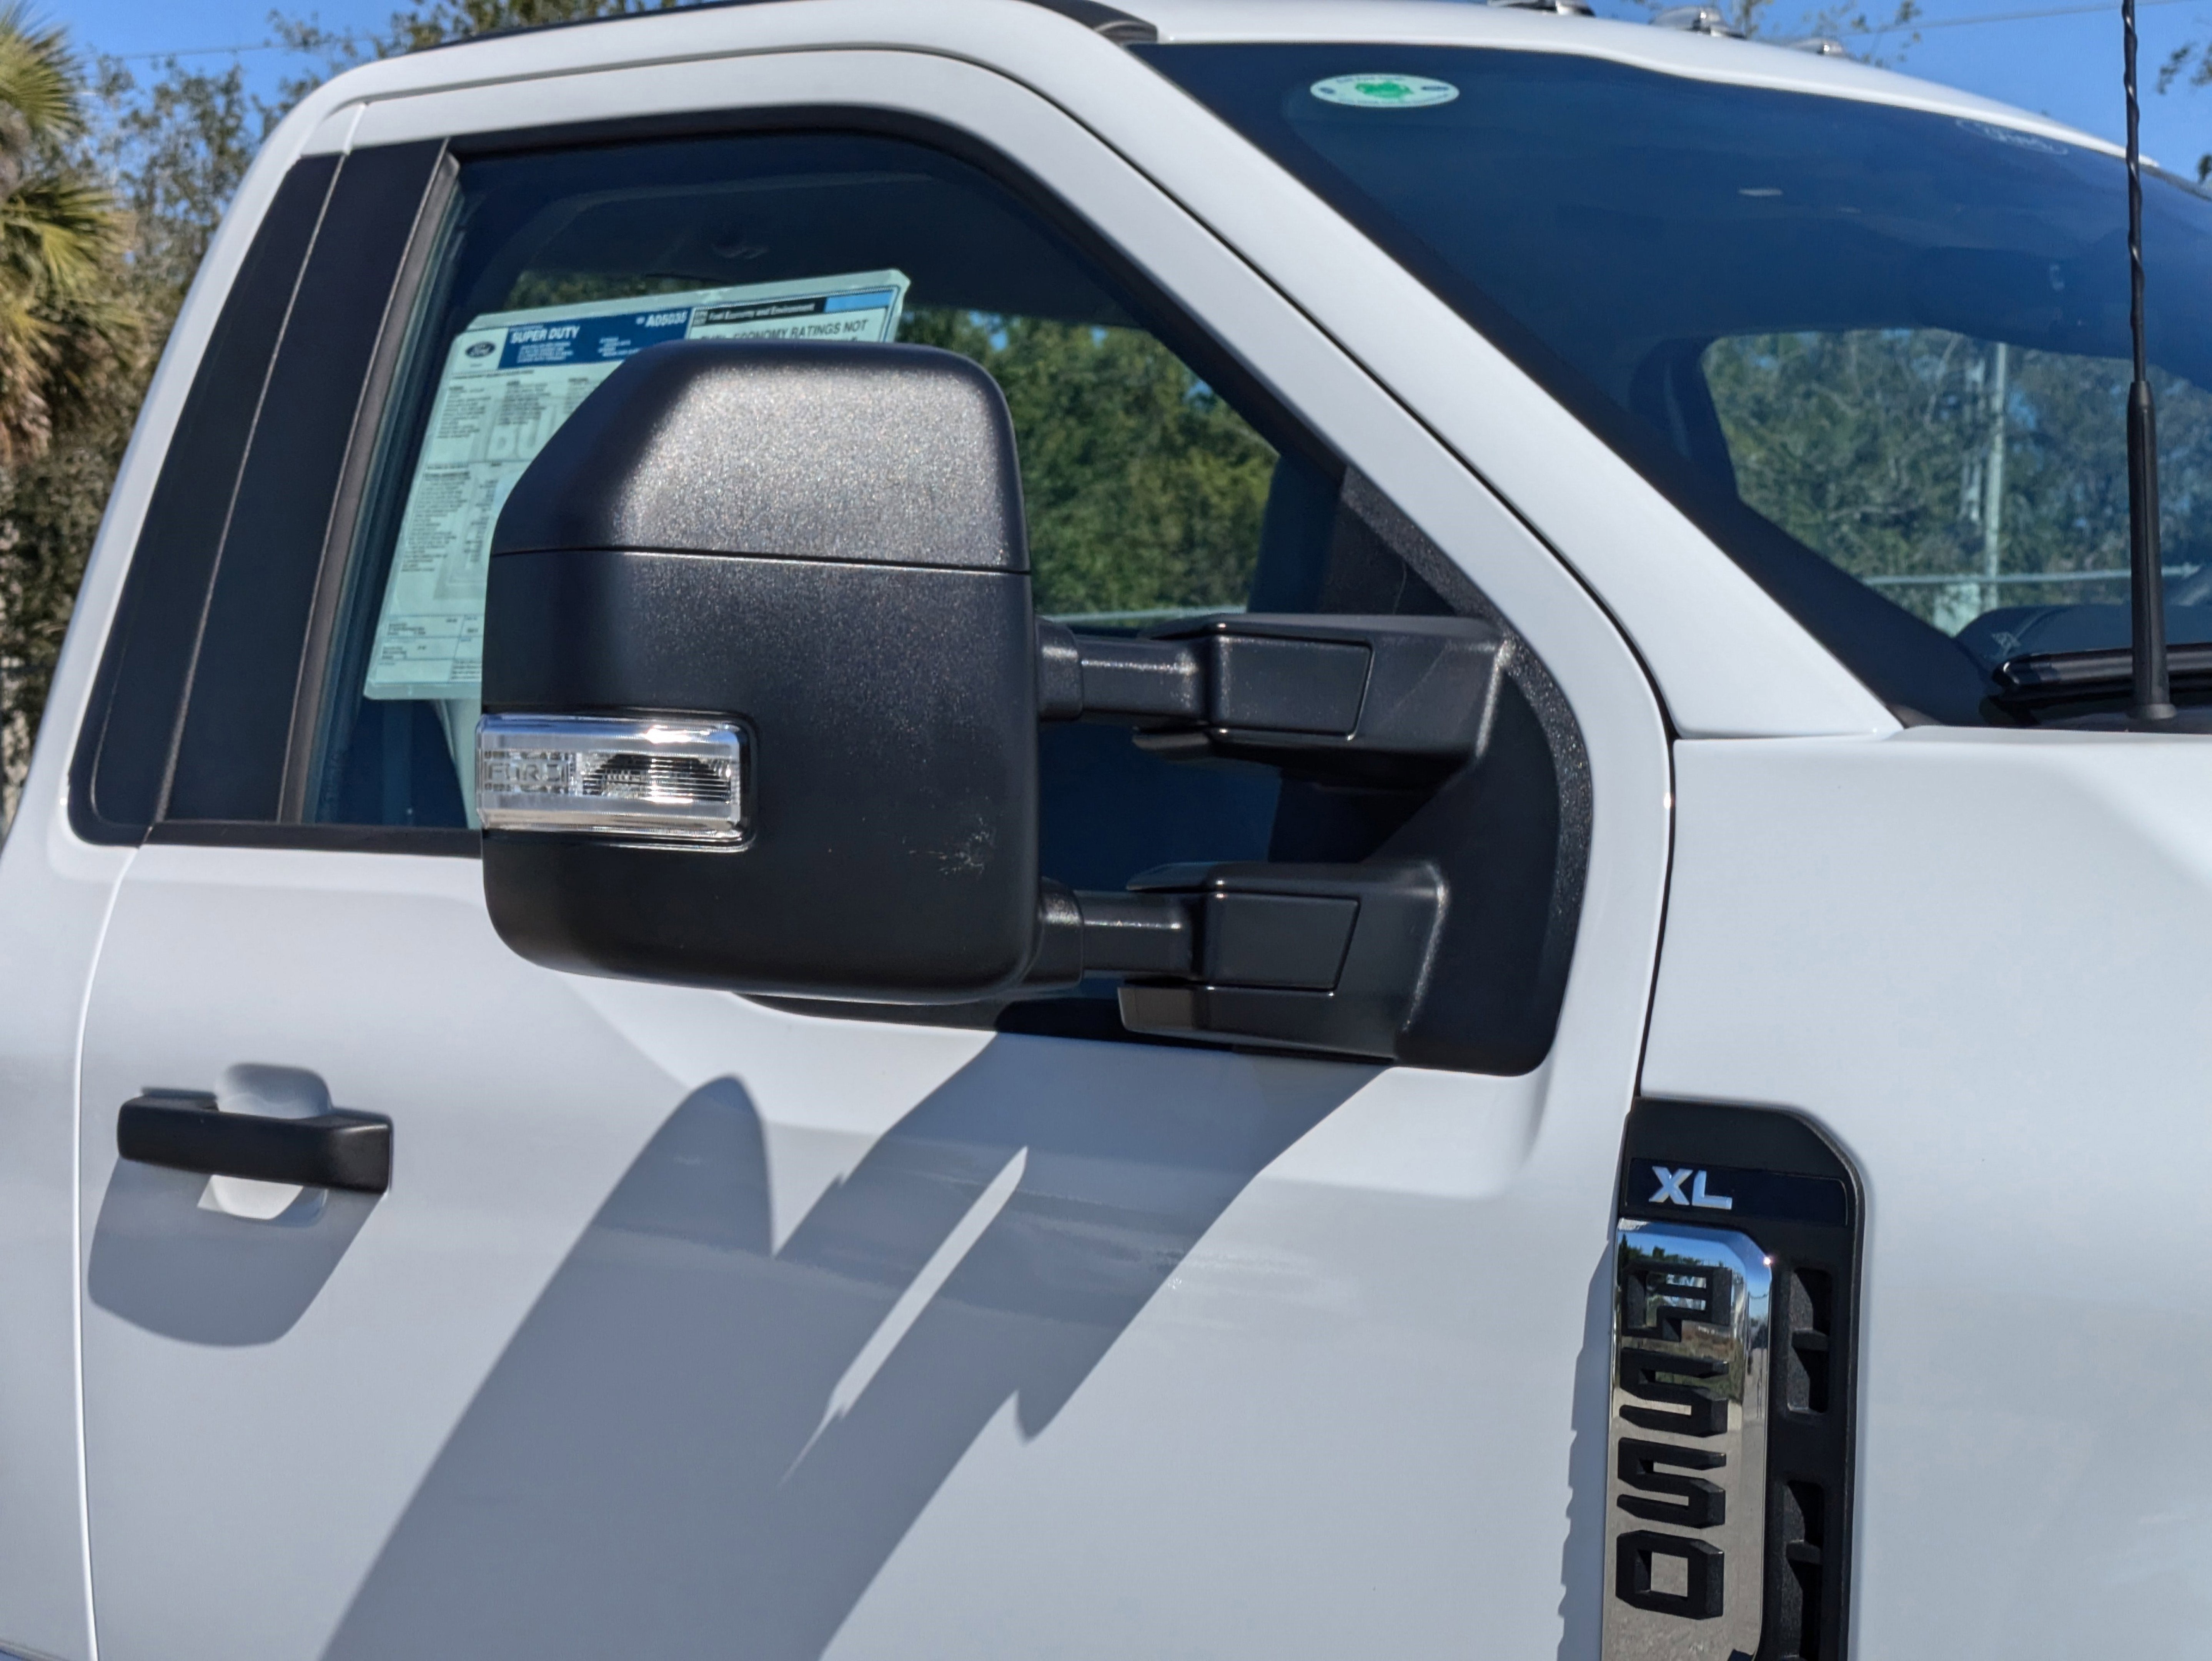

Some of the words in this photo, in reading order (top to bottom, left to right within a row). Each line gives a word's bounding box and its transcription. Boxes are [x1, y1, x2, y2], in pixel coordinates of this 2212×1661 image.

[510, 326, 546, 344] SUPER
[548, 325, 580, 340] DUTY
[791, 322, 841, 338] RATINGS
[842, 319, 869, 333] NOT
[488, 762, 564, 782] FORD
[1649, 1166, 1733, 1210] XL
